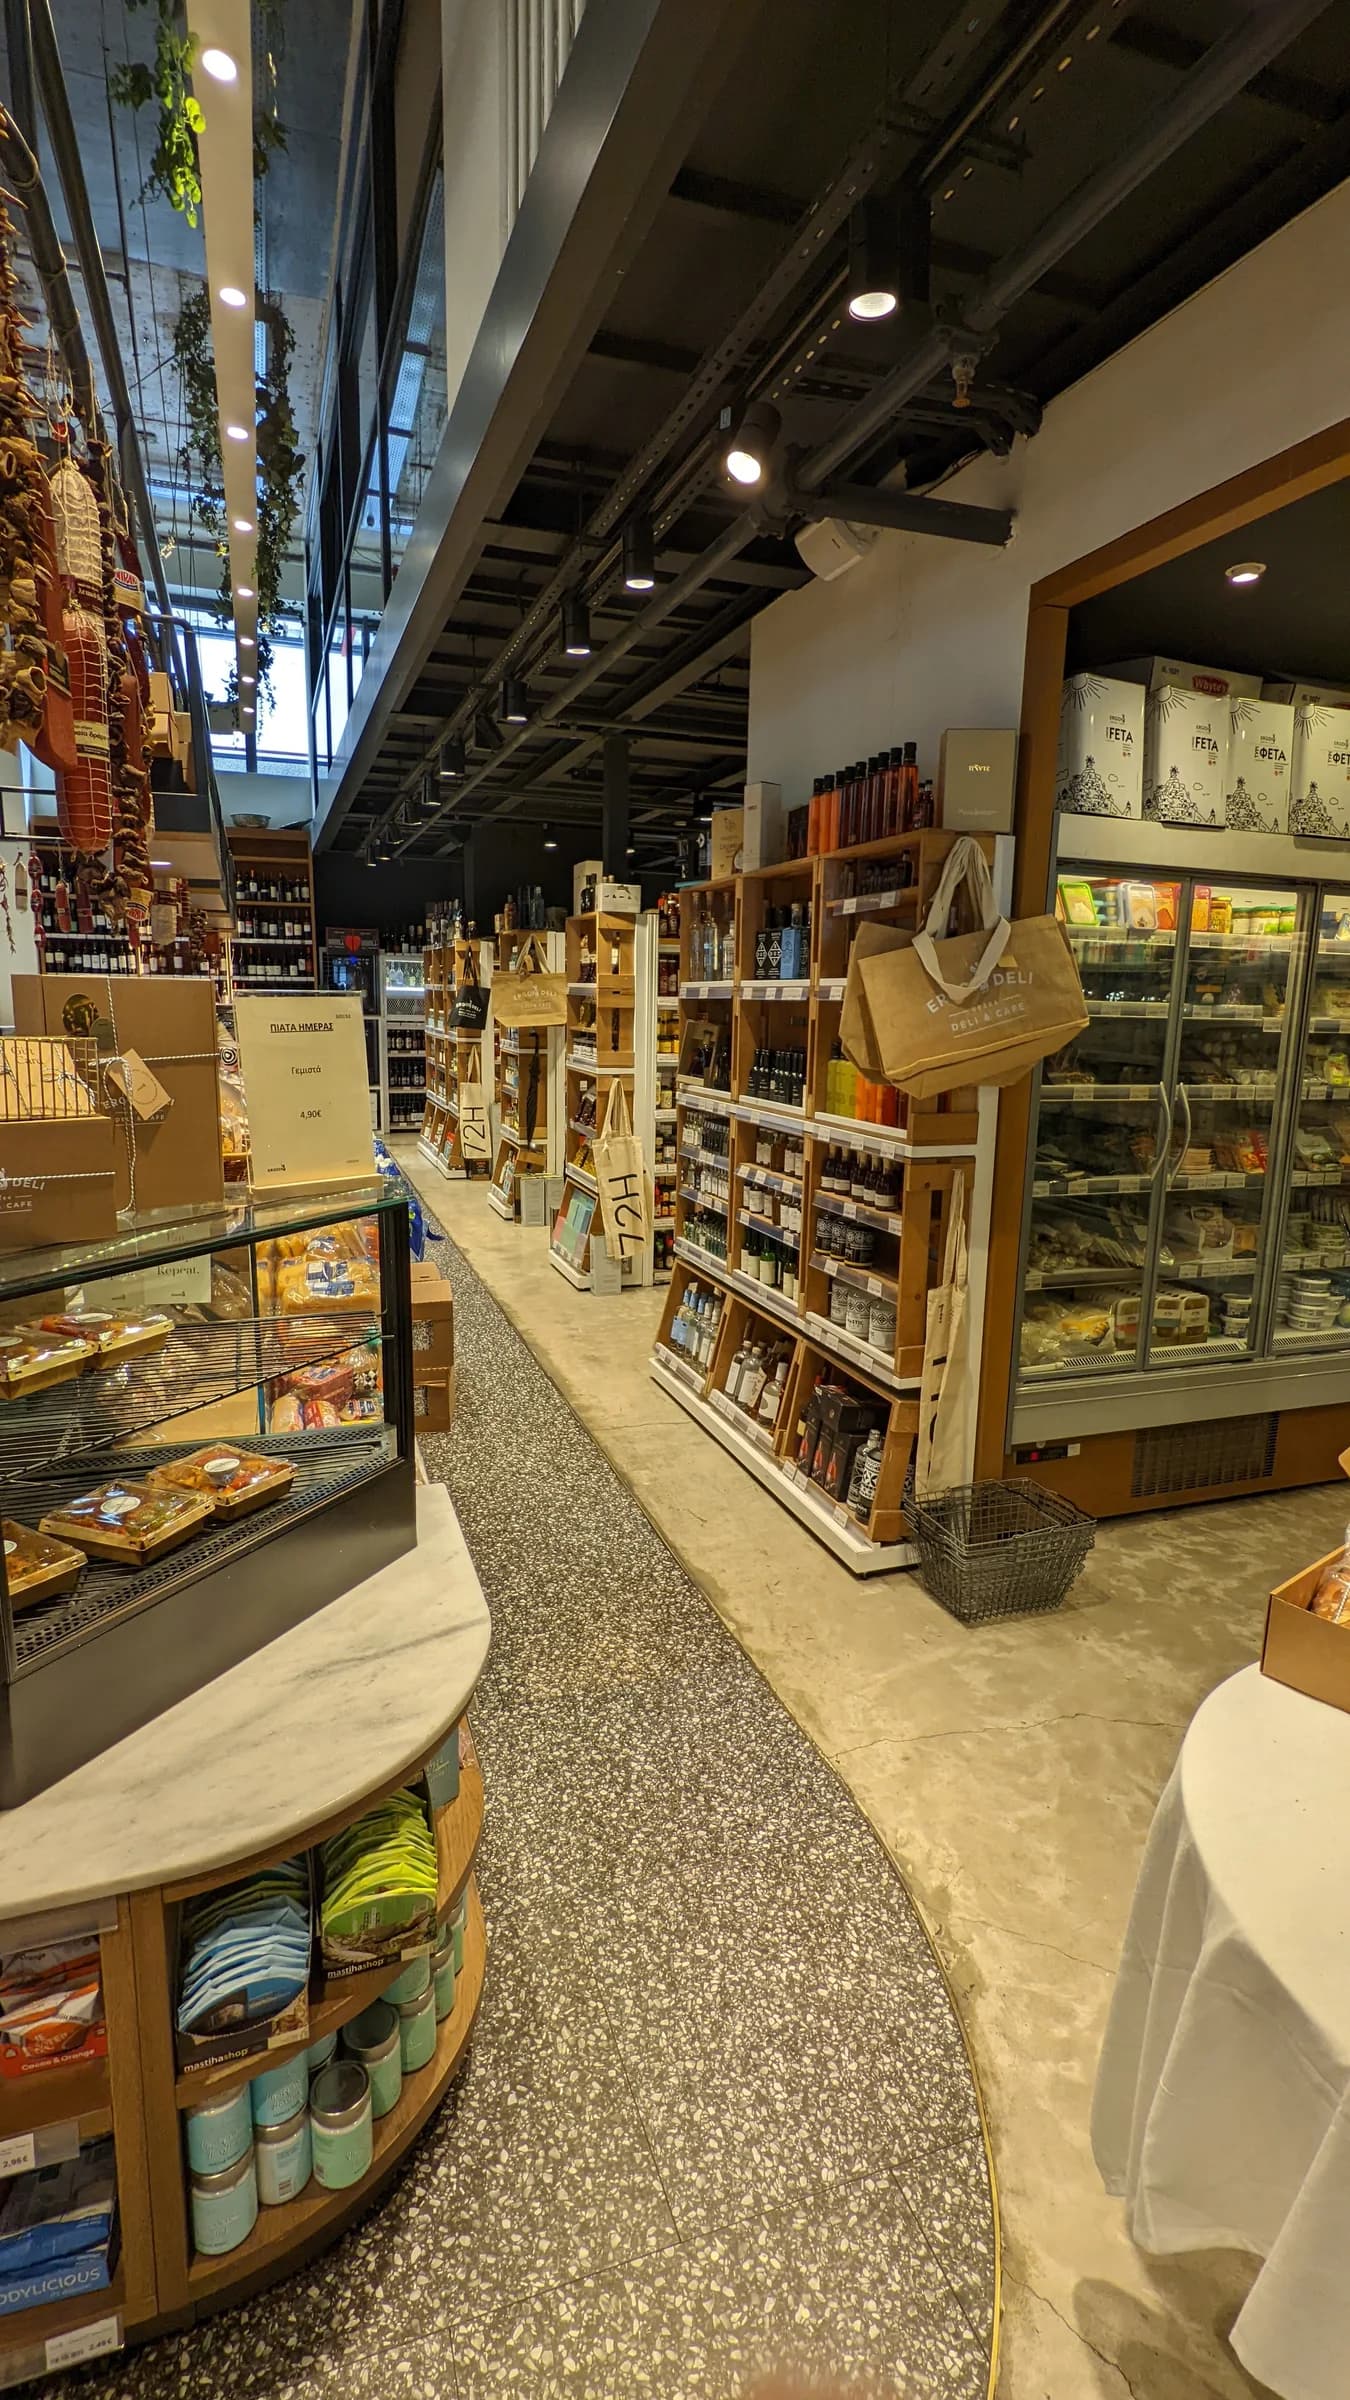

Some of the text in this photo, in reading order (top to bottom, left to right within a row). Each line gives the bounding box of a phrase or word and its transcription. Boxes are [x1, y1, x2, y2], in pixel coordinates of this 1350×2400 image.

[1109, 727, 1134, 743] FETA
[1195, 737, 1219, 752] FETA
[1259, 747, 1286, 761] ΦΕΤΑ
[1332, 752, 1350, 765] ΦΕΤ
[993, 971, 1033, 985] DELI
[951, 1016, 979, 1032] DELI
[995, 1001, 1025, 1017] CAFE
[270, 1022, 334, 1032] ΠΙΑΤΑ ΗΜΕΡΑΣ
[291, 1065, 322, 1075] Γεμιστά
[300, 1110, 322, 1119] 4,90€
[462, 1106, 487, 1157] 72H
[12, 1178, 46, 1190] DELI
[6, 1200, 33, 1208] CAFE
[608, 1173, 645, 1255] 72H
[157, 1265, 200, 1276] Repeat.
[327, 1959, 384, 1979] mastihashop
[61, 2048, 96, 2062] Orange
[183, 2047, 249, 2073] mastihashop
